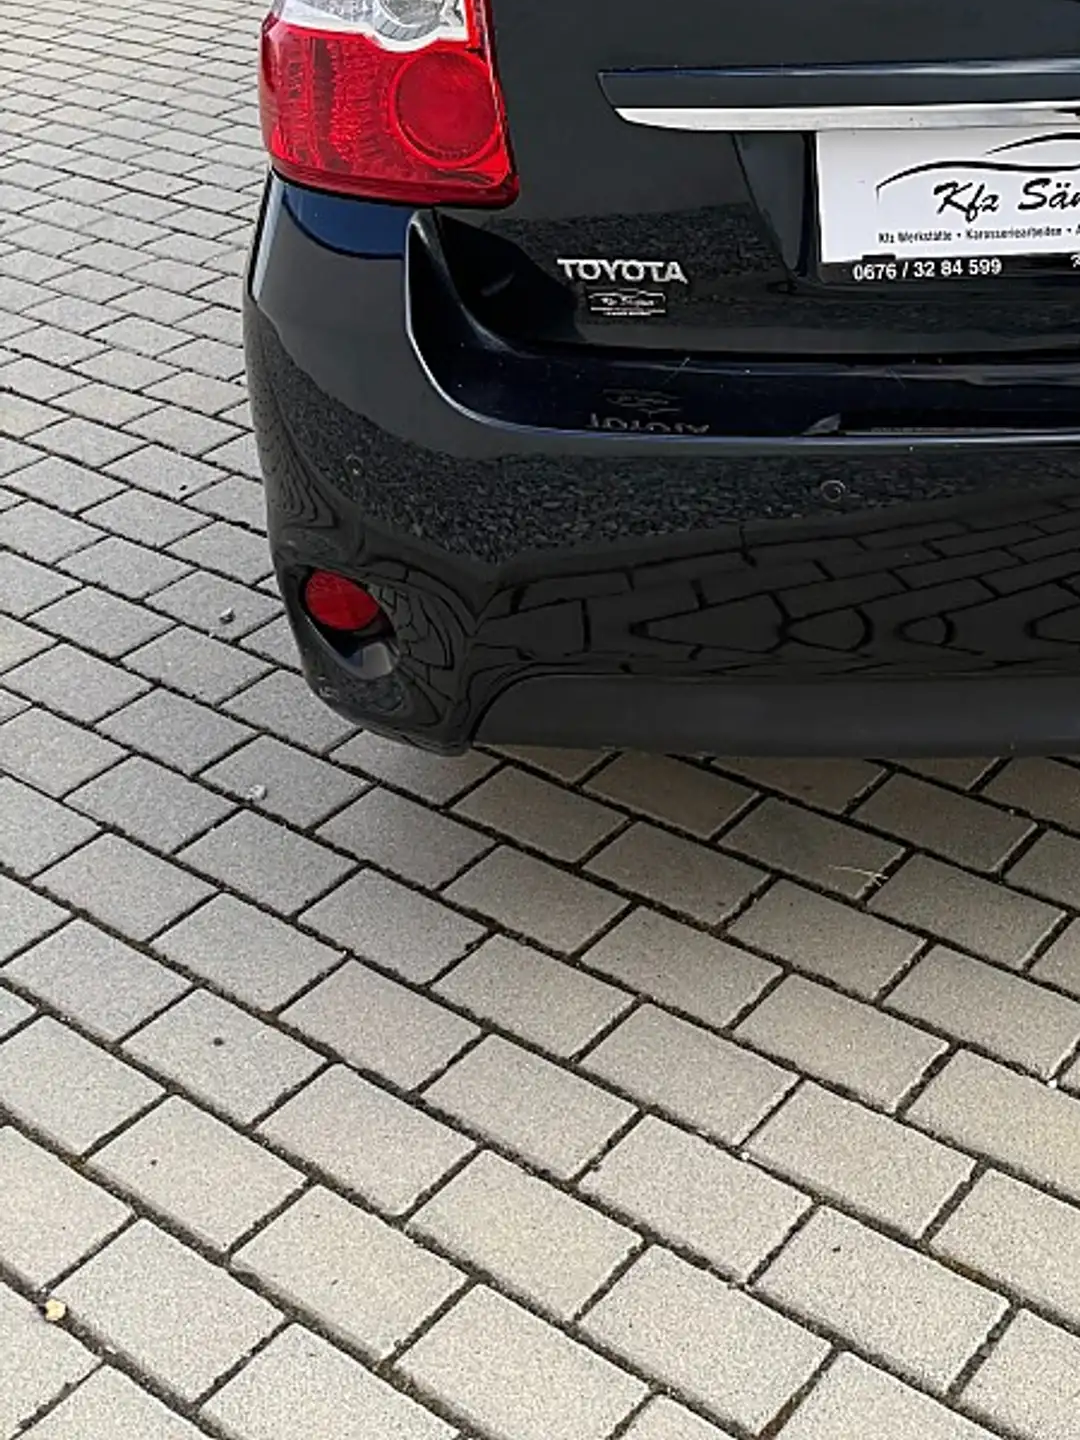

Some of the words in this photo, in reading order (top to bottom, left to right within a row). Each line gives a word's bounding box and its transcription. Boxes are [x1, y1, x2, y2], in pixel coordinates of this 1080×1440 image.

[933, 180, 1000, 222] Kfz
[557, 258, 689, 285] TOYOTA
[853, 263, 897, 281] 0676
[914, 261, 935, 278] 32
[941, 259, 963, 276] 84
[968, 258, 1002, 275] 599
